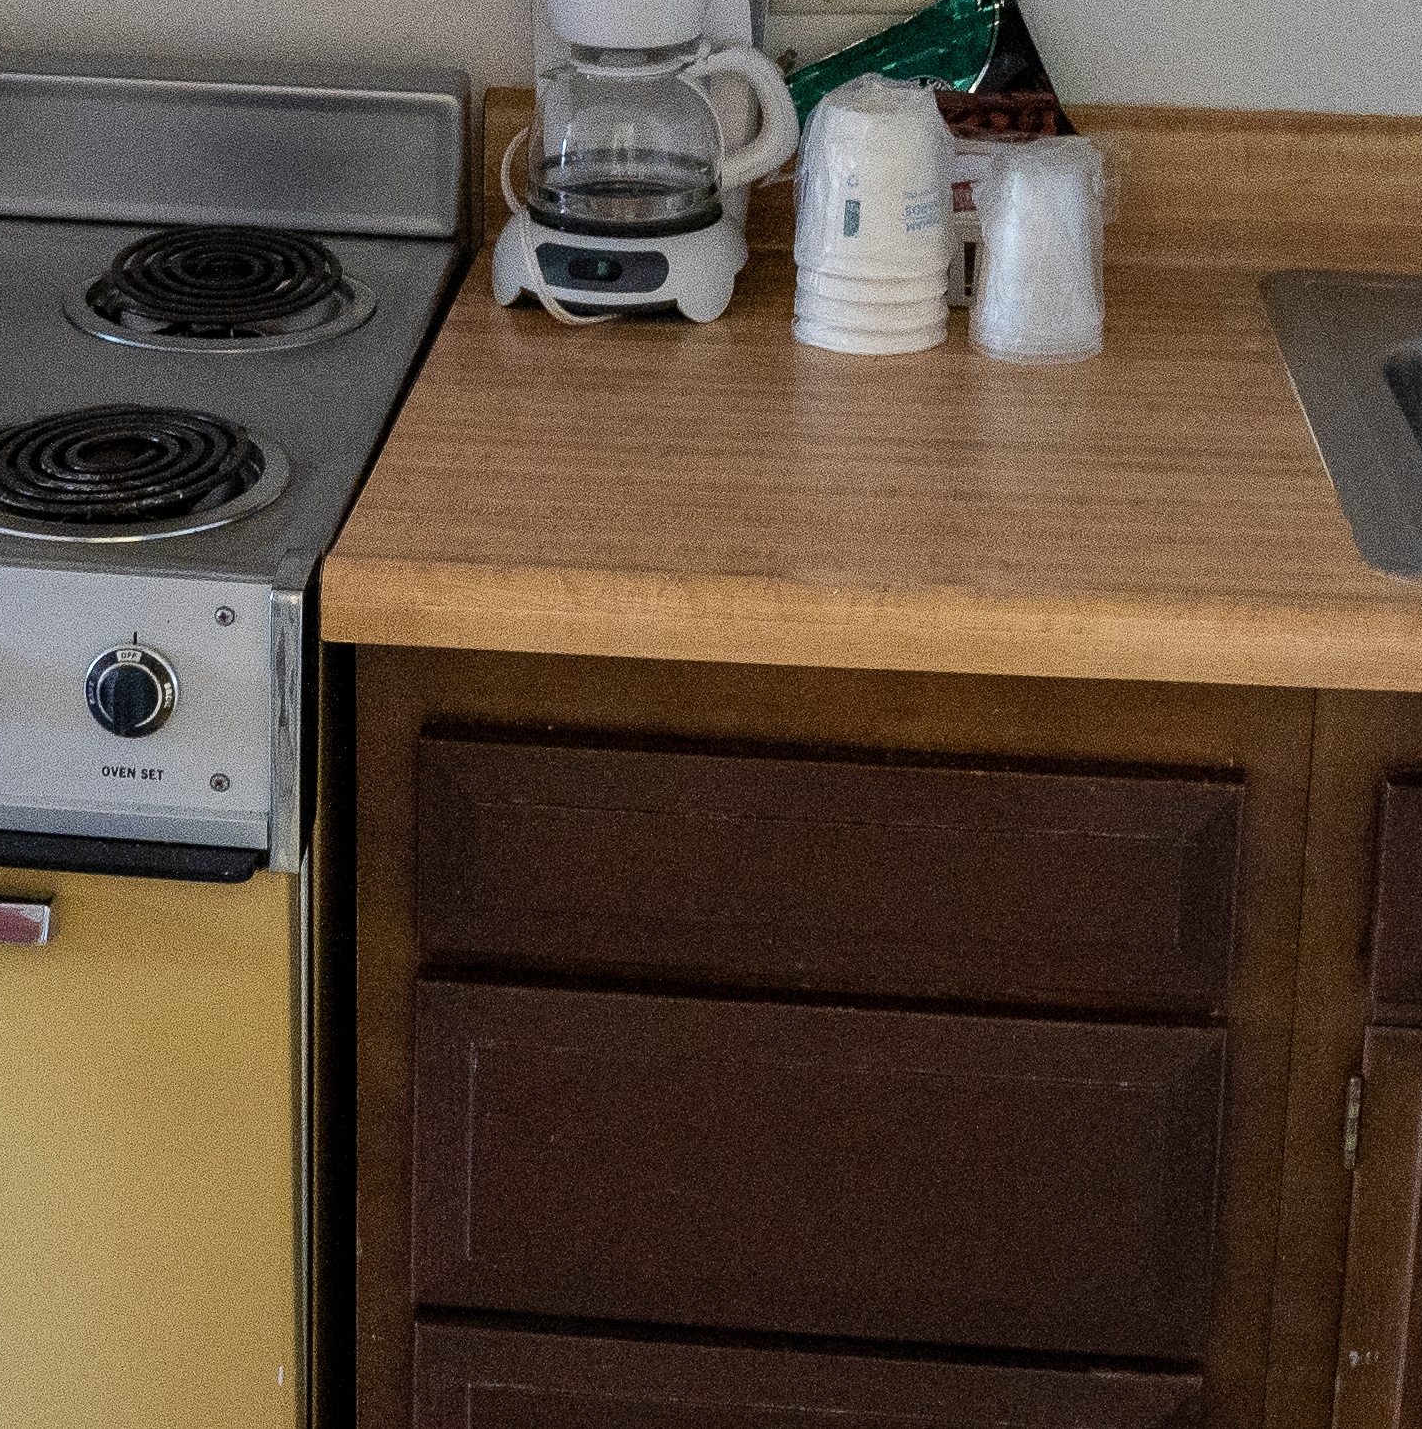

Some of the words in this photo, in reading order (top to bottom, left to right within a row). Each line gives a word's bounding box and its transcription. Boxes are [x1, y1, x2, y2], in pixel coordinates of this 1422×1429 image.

[121, 651, 137, 659] OFF
[101, 766, 136, 779] OVEN
[141, 768, 164, 781] SET
